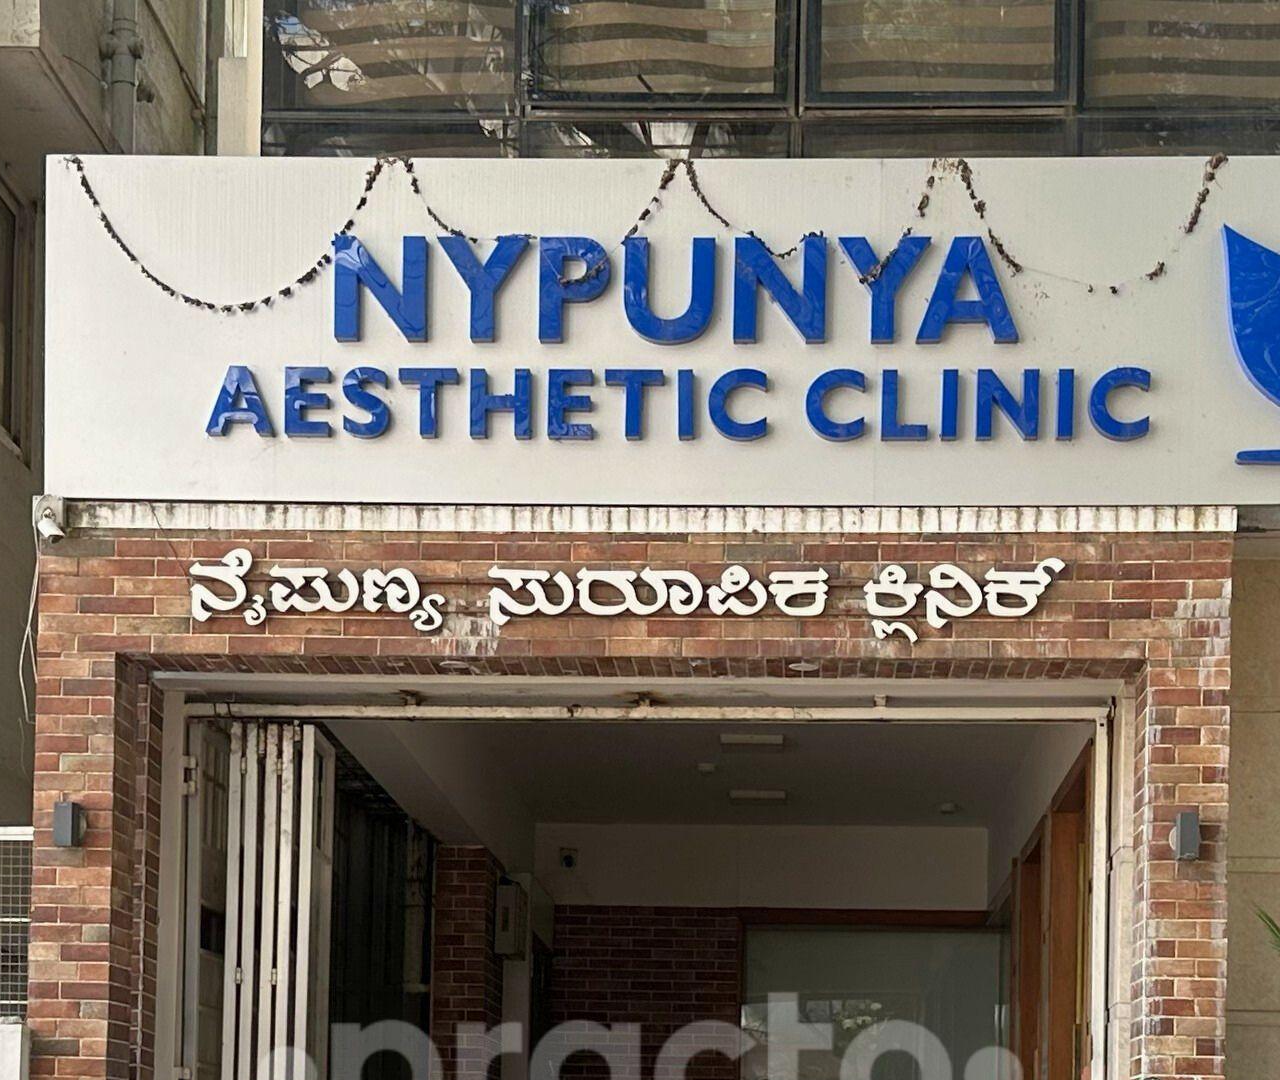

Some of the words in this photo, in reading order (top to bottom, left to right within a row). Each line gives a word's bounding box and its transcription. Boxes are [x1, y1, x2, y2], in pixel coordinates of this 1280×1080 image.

[330, 233, 1019, 345] NYPUNYA
[206, 366, 769, 442] AESTHETIC
[804, 366, 1152, 443] CLINIC
[189, 548, 445, 631] ನೈಪುಣ್ಯ
[487, 565, 829, 625] ಸುರೂಪಿಕ
[863, 557, 1066, 643] ಕ್ಲಿನಿಕ್
